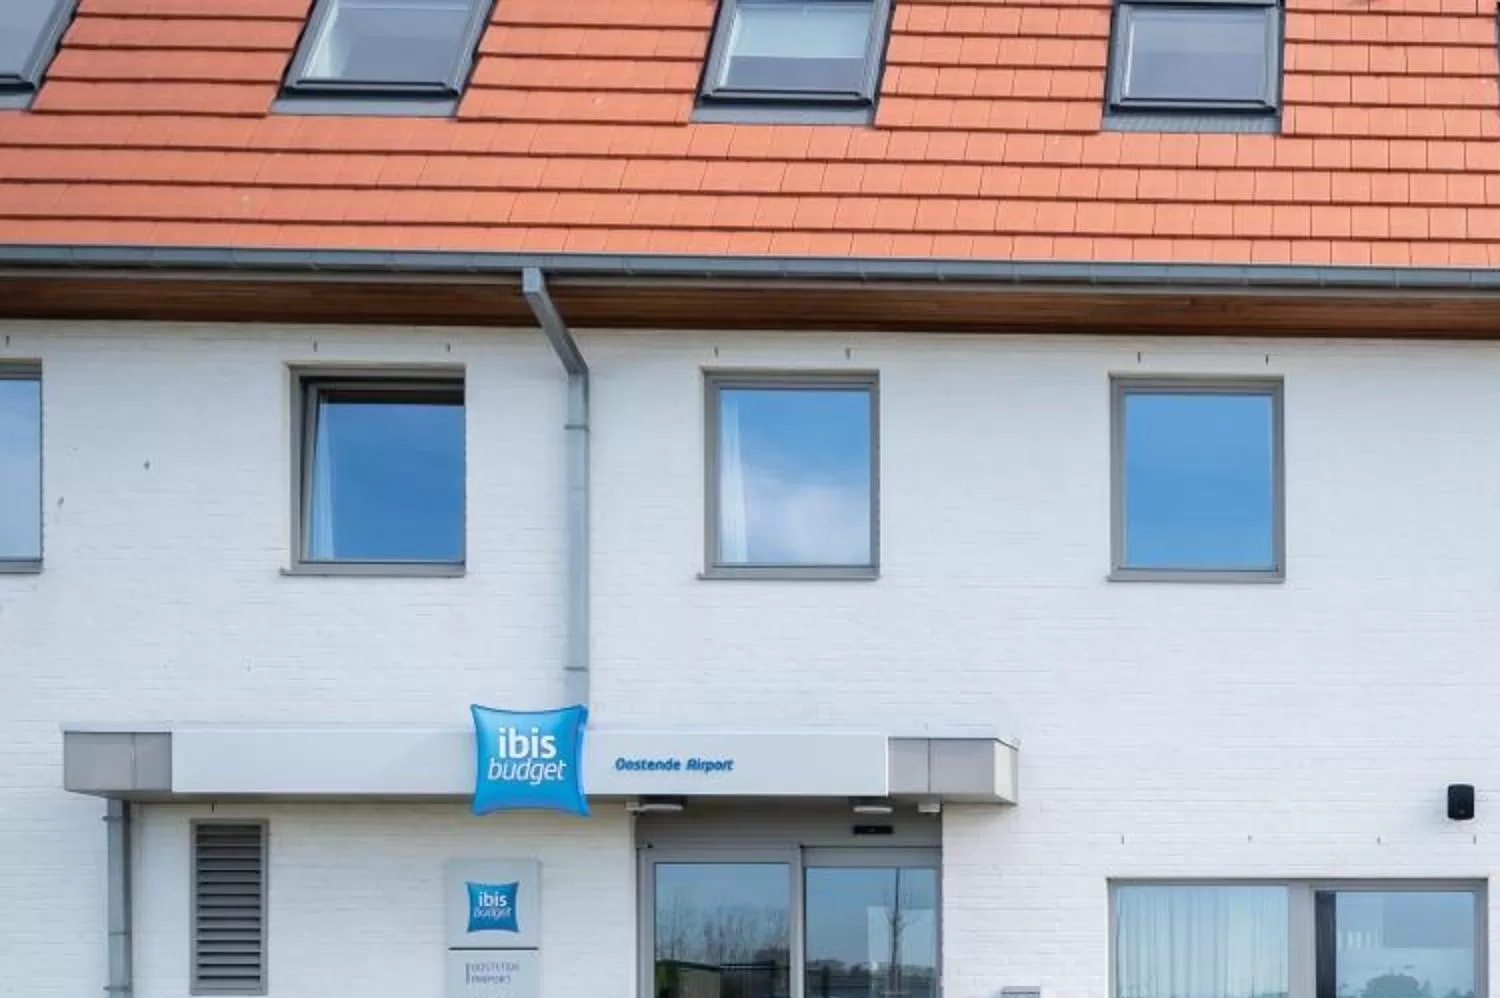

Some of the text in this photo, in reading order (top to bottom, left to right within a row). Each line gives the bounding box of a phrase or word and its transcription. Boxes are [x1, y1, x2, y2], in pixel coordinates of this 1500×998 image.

[498, 727, 556, 758] ibis
[488, 758, 566, 785] budget
[615, 757, 734, 773] Oostende Airport
[478, 891, 507, 907] ibis
